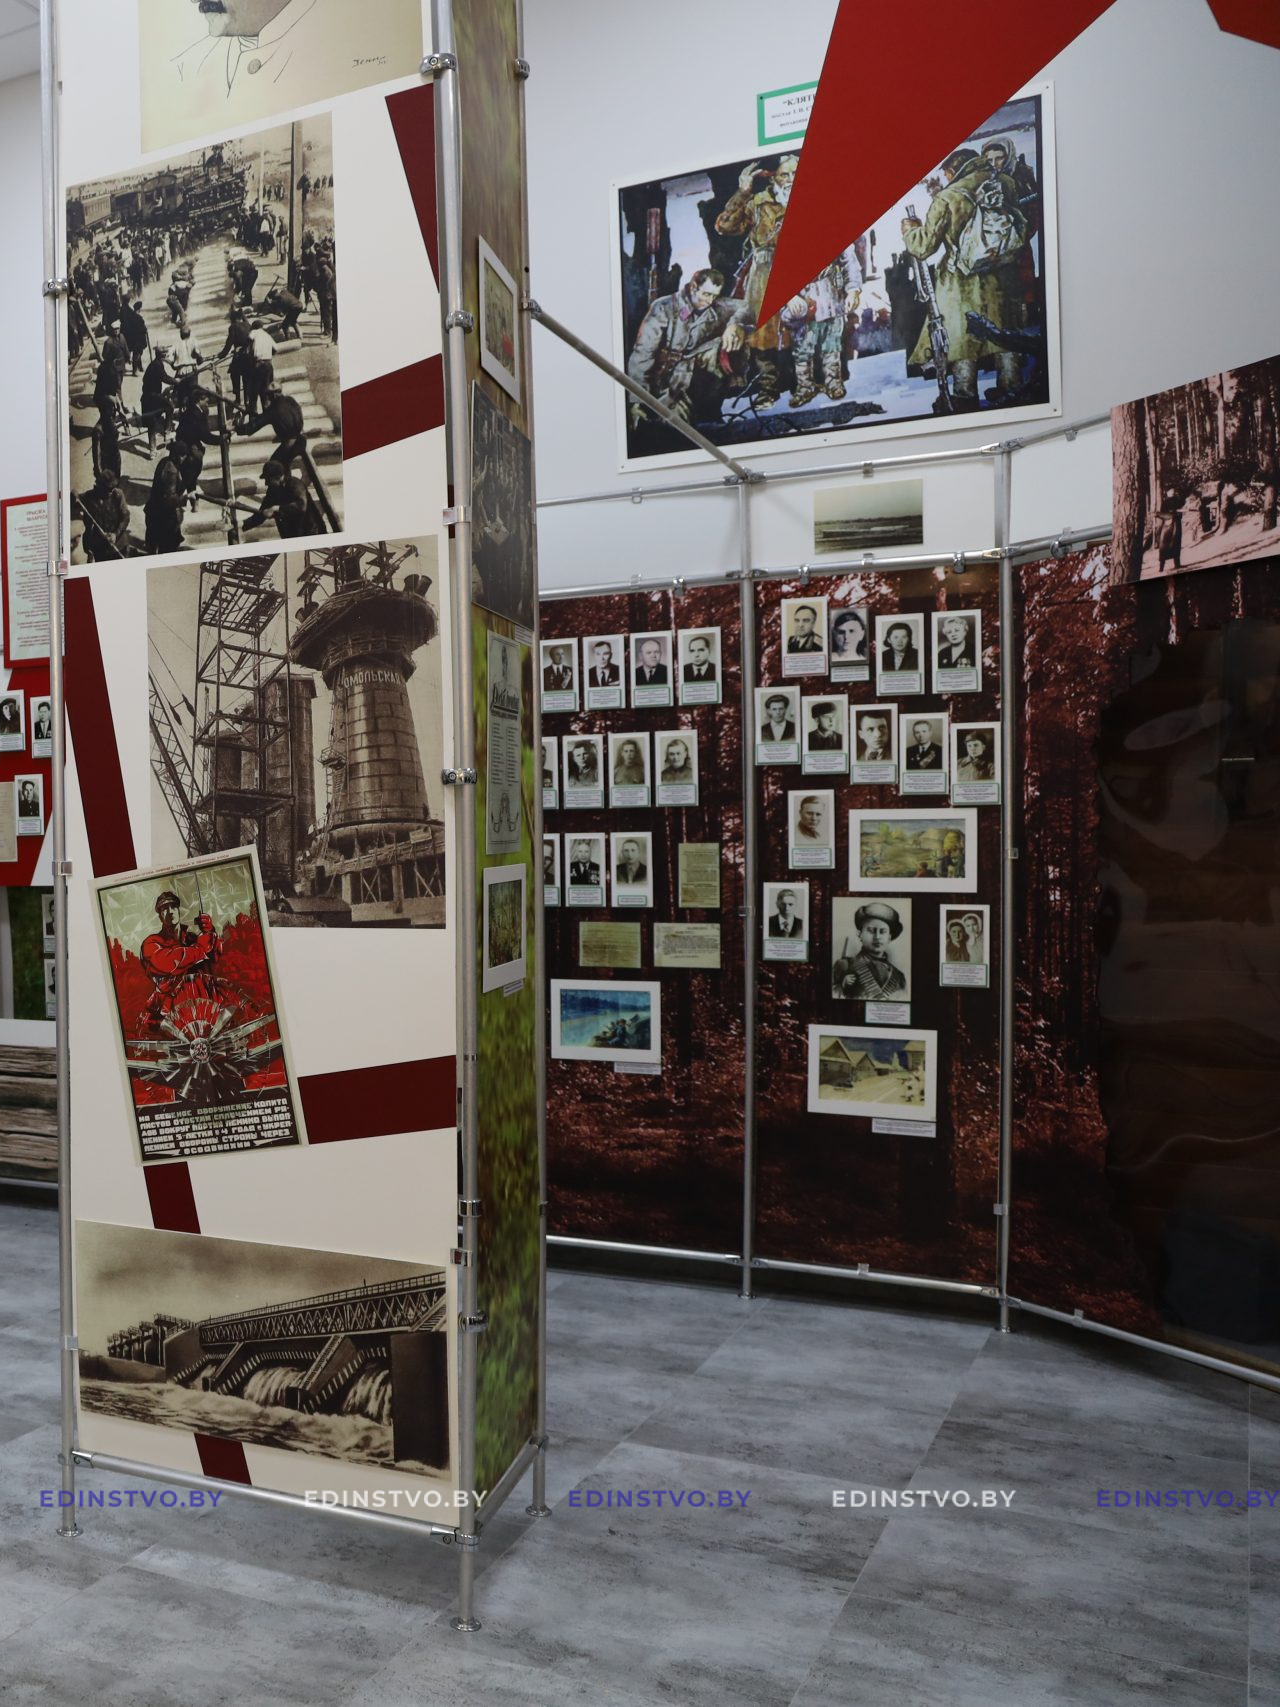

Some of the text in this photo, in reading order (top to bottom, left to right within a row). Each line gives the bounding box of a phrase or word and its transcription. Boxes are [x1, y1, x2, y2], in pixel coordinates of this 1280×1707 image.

[140, 1120, 171, 1130] ЛИСТОВ
[159, 1125, 190, 1135] ВОКРУГ
[180, 1137, 218, 1147] ОБОРОНЫ
[261, 1129, 290, 1138] ЧЕРЕЗ
